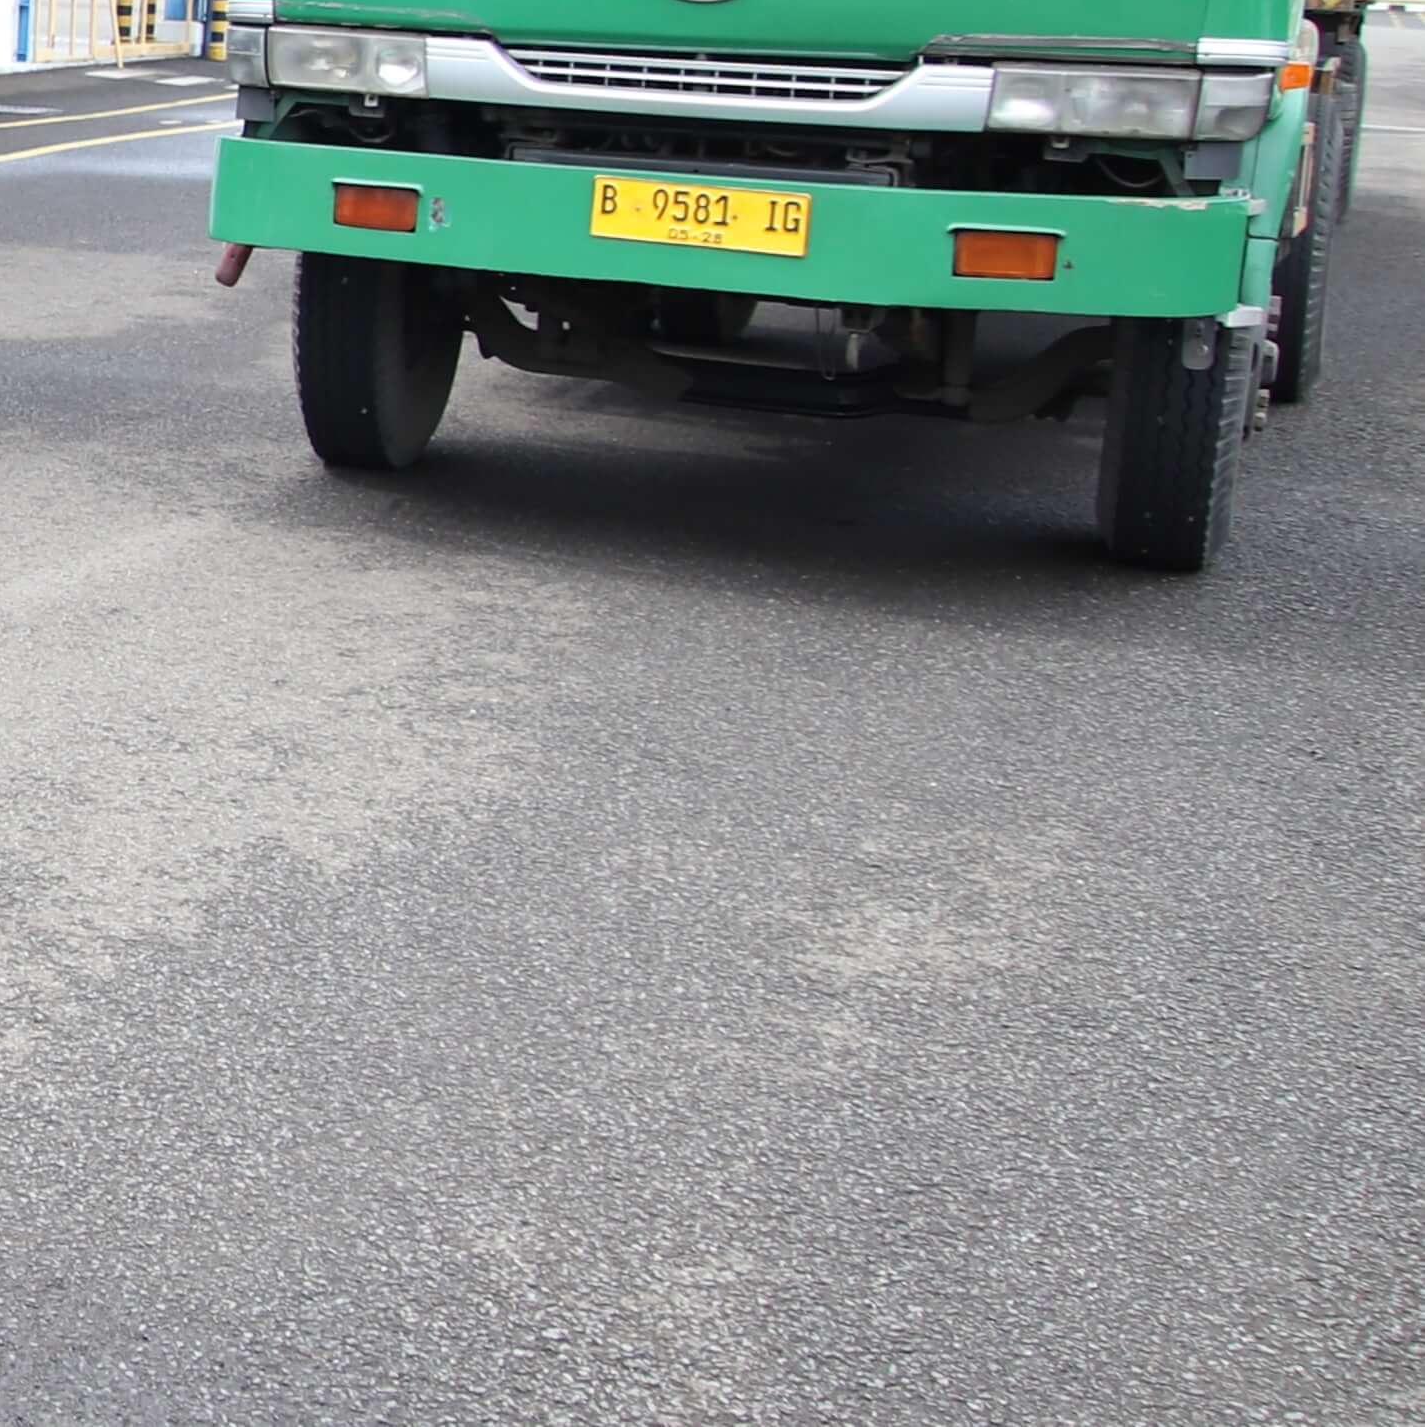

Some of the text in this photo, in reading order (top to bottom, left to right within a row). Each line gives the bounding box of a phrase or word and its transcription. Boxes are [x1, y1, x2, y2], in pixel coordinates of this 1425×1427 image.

[601, 184, 802, 233] B 9581 IG
